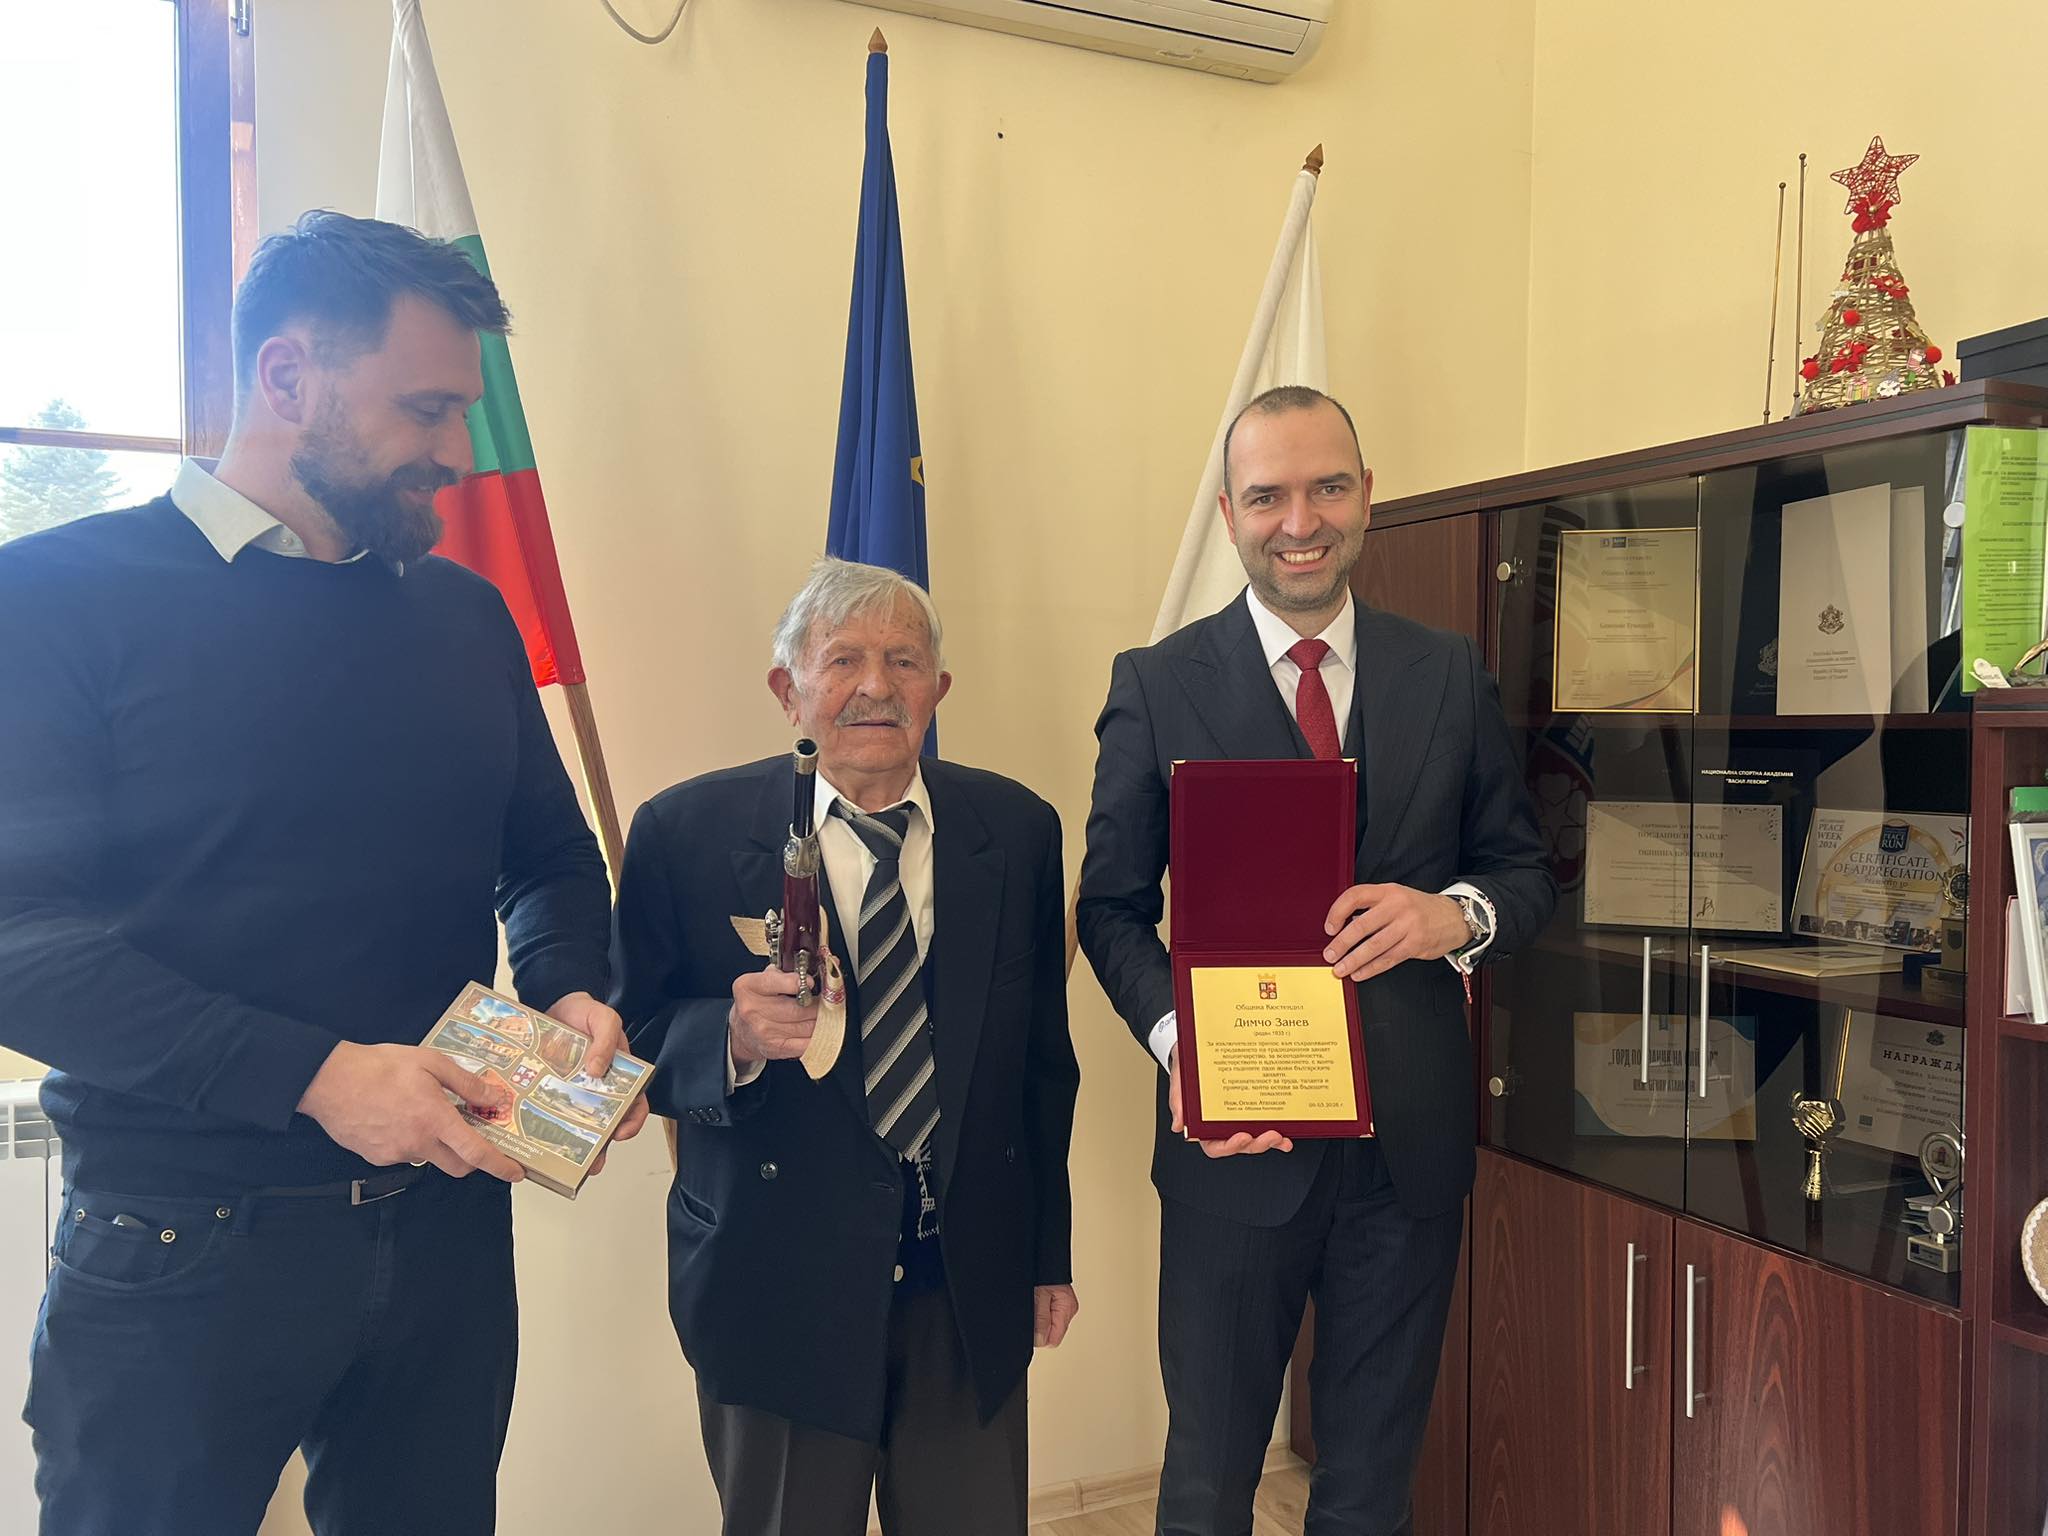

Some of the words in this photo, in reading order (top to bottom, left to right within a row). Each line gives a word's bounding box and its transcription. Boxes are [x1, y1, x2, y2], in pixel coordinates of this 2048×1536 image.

[1818, 823, 1845, 832] PEACE
[1817, 831, 1843, 841] WEEK
[1818, 840, 1838, 849] 2024
[1881, 840, 1905, 849] RUN
[1850, 852, 1930, 869] CERTIFICATE
[1833, 863, 1850, 874] OF
[1851, 864, 1948, 882] APPRECIATION
[1234, 1017, 1272, 1028] Димчо
[1275, 1017, 1309, 1027] Занев
